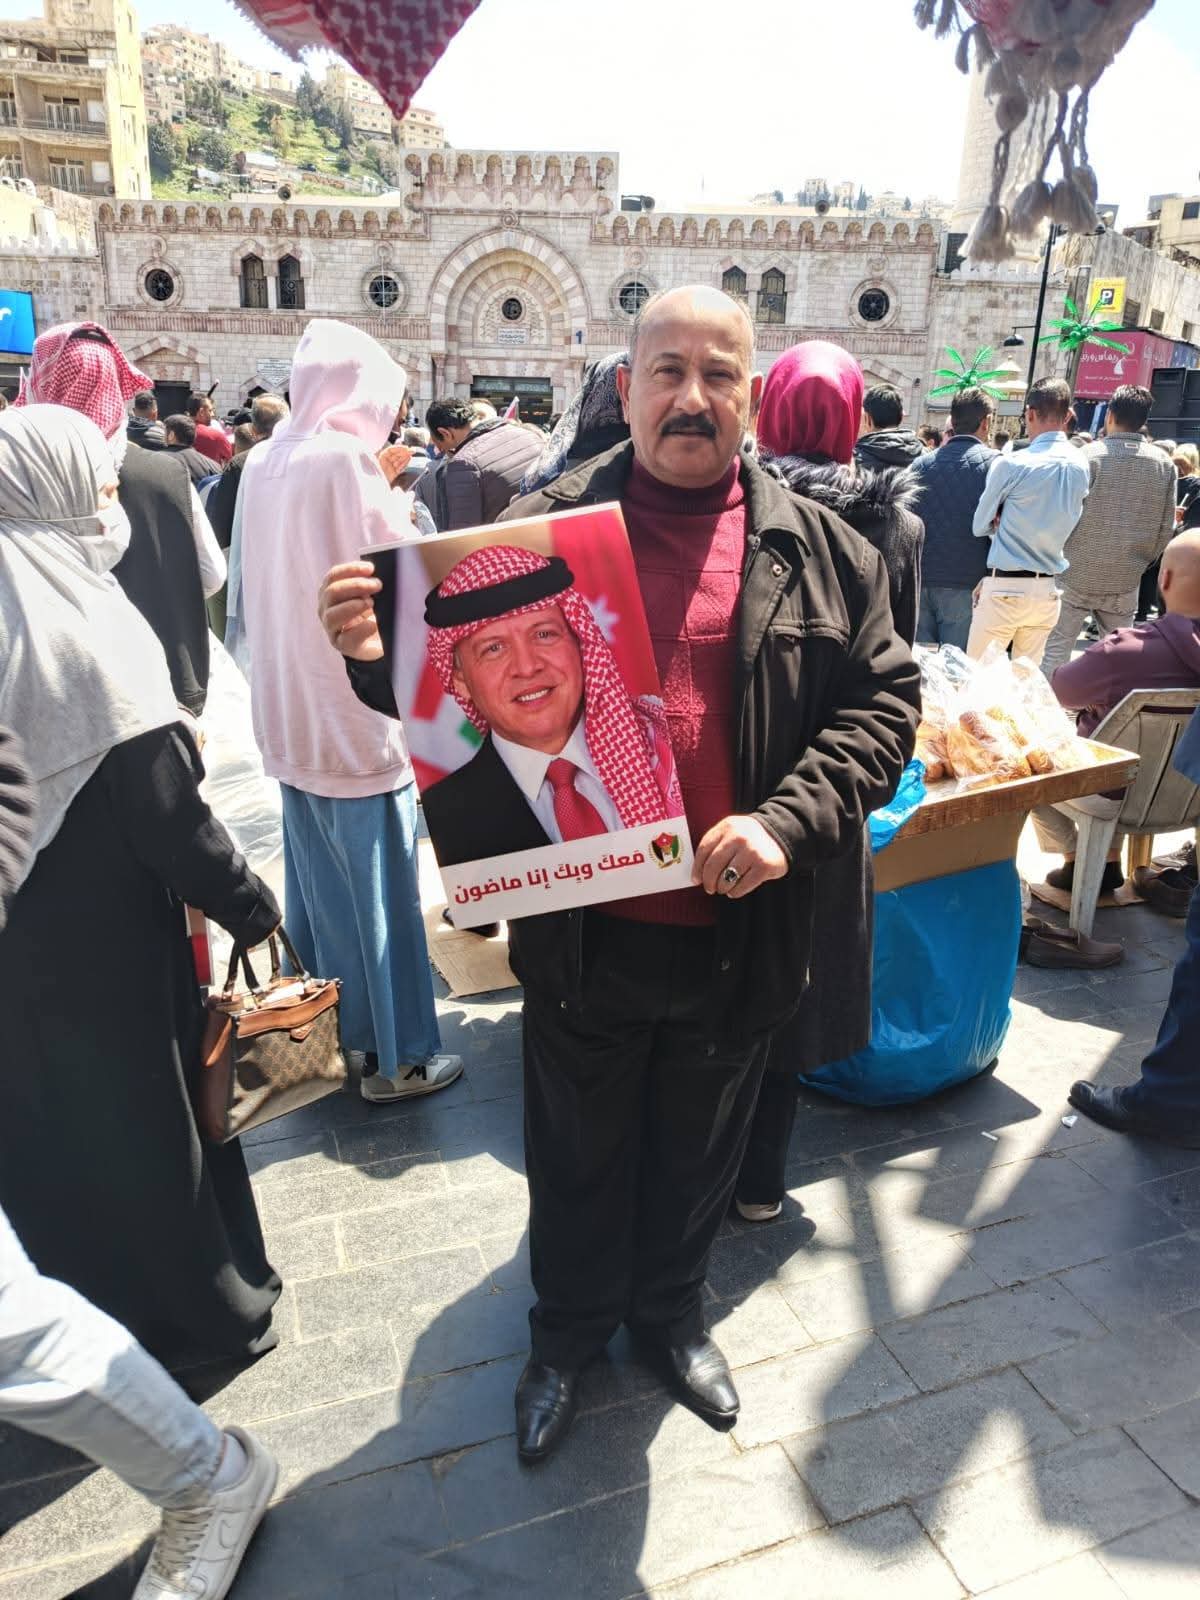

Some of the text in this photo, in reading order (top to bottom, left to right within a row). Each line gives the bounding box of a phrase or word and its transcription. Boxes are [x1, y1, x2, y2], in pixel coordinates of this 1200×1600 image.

[1102, 290, 1113, 303] P
[526, 868, 551, 889] إنا
[455, 876, 523, 904] ماضون
